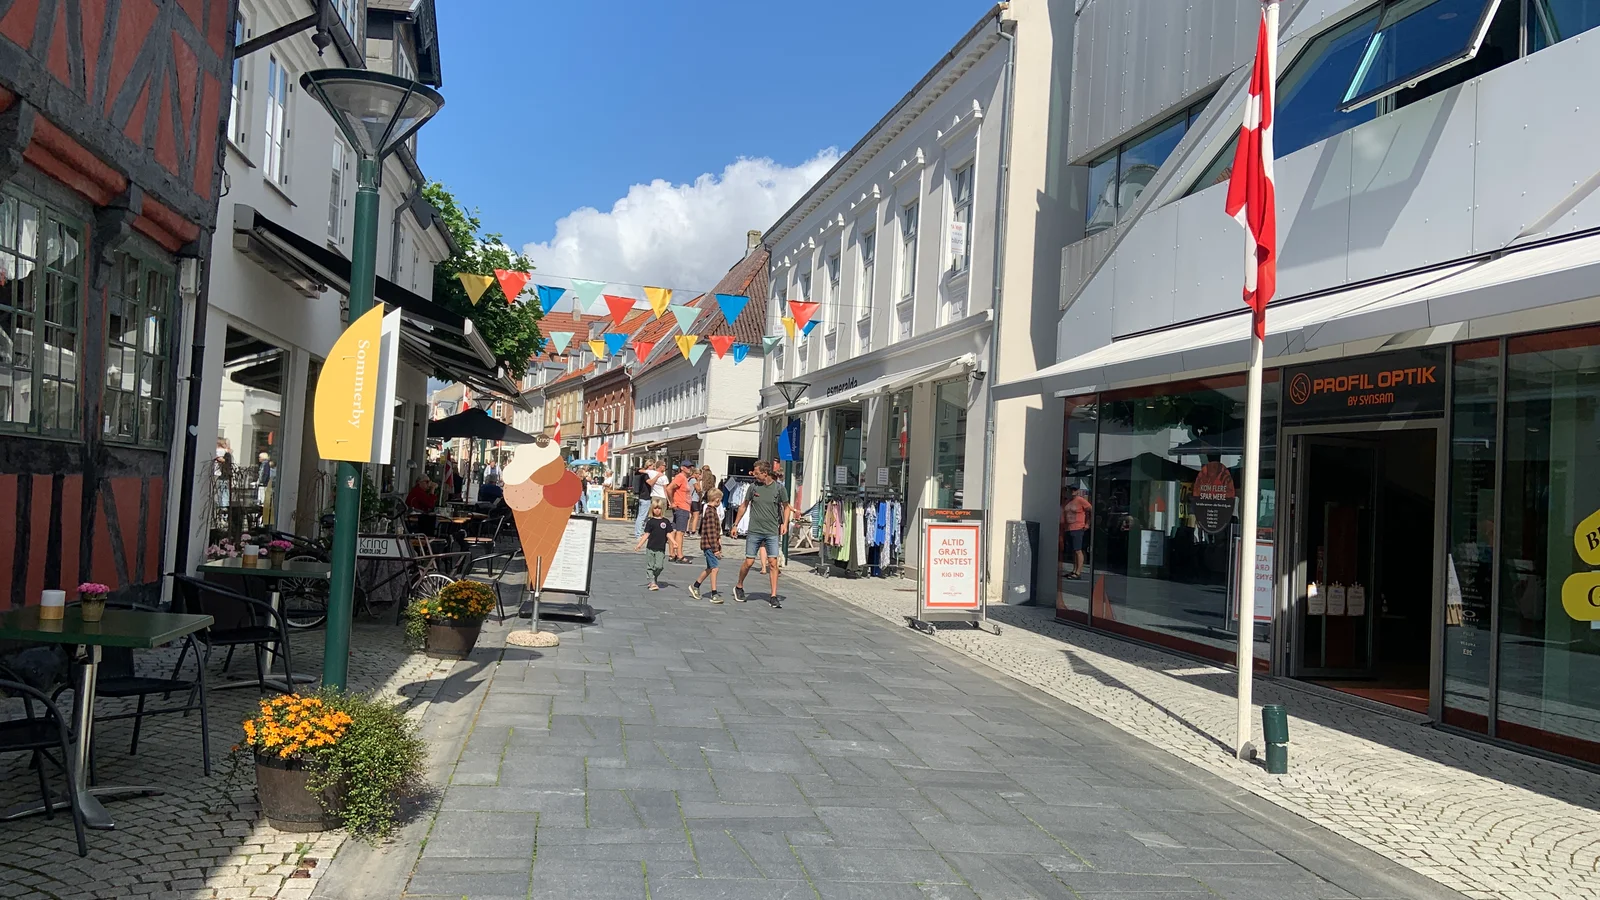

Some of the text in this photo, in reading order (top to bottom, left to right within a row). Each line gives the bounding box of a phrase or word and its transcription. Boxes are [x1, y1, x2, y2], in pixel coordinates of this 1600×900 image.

[348, 339, 371, 429] Sommerby
[826, 376, 858, 398] esmeralda
[1313, 366, 1437, 394] PROFIL OPTIK
[1347, 392, 1394, 406] BY SYNSAM
[1212, 493, 1227, 501] MERE
[359, 537, 389, 555] Kring
[941, 538, 965, 546] ALTID
[1586, 526, 1600, 552] B
[938, 548, 968, 556] GRATIS
[933, 557, 973, 566] SYNSTEST
